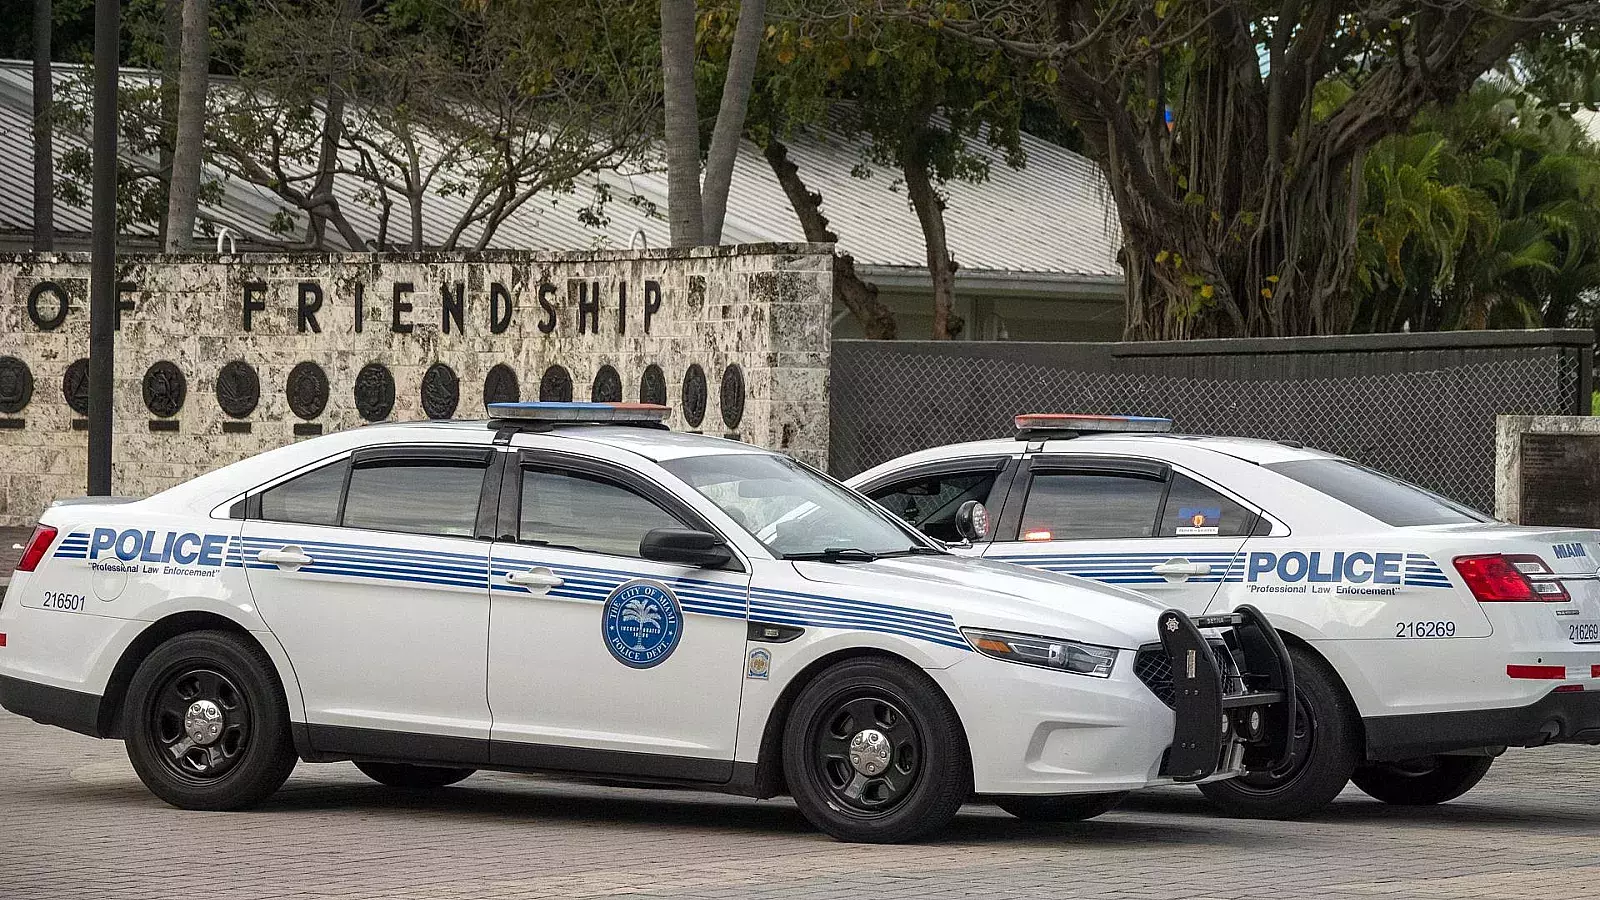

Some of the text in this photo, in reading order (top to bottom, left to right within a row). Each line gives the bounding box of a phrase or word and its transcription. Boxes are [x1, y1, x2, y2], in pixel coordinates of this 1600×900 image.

[27, 281, 662, 335] OF FRIENDSHIP
[89, 527, 229, 567] POLICE
[1552, 543, 1586, 559] MIAMI
[142, 564, 160, 574] Law
[1247, 551, 1403, 585] POLICE
[1311, 585, 1331, 594] Law
[43, 591, 86, 611] 216501
[609, 586, 676, 624] THE CITY OF MIAMI
[1396, 621, 1456, 638] 216269
[1569, 624, 1599, 640] 216269
[612, 637, 669, 660] POLICE DEPT.
